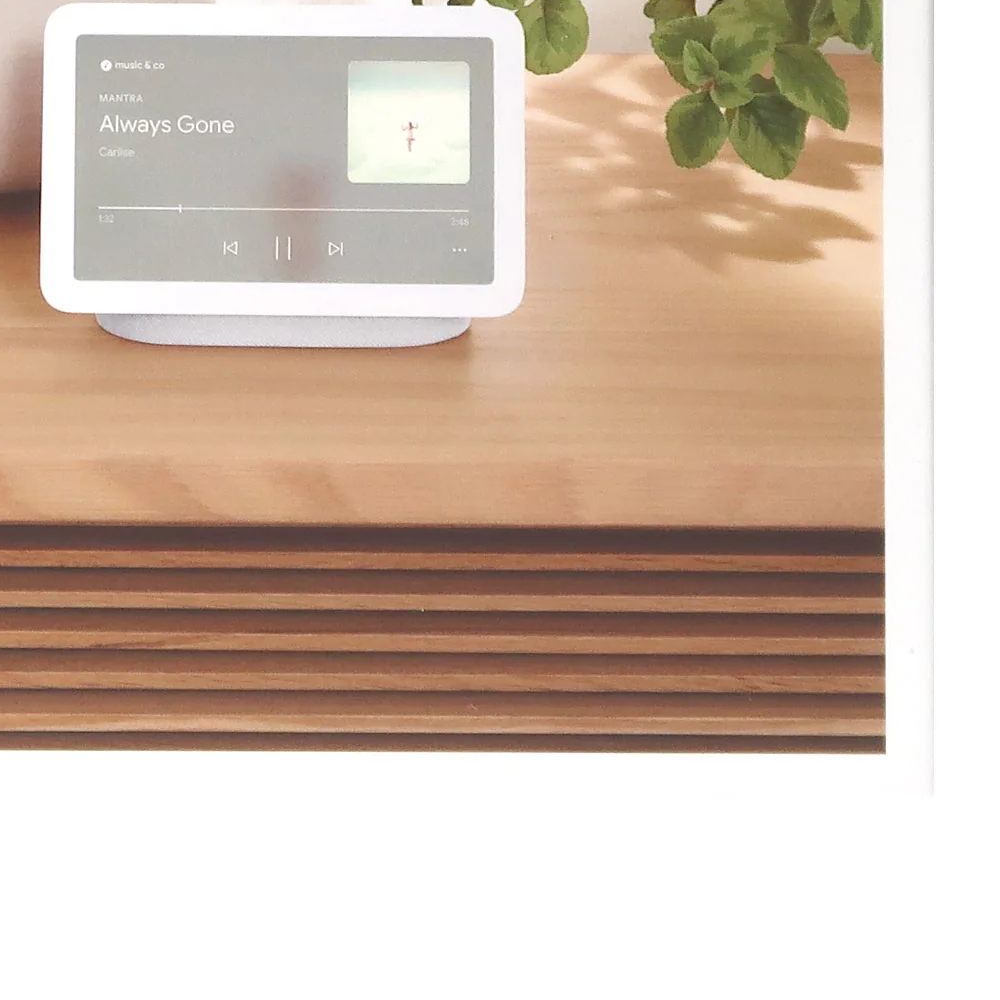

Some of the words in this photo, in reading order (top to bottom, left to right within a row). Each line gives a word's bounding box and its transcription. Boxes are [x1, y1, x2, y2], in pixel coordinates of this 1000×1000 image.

[114, 60, 143, 70] music
[144, 61, 151, 70] &
[152, 62, 165, 70] co
[99, 93, 144, 103] MANTRA
[99, 114, 172, 138] Always
[176, 114, 235, 134] Gone
